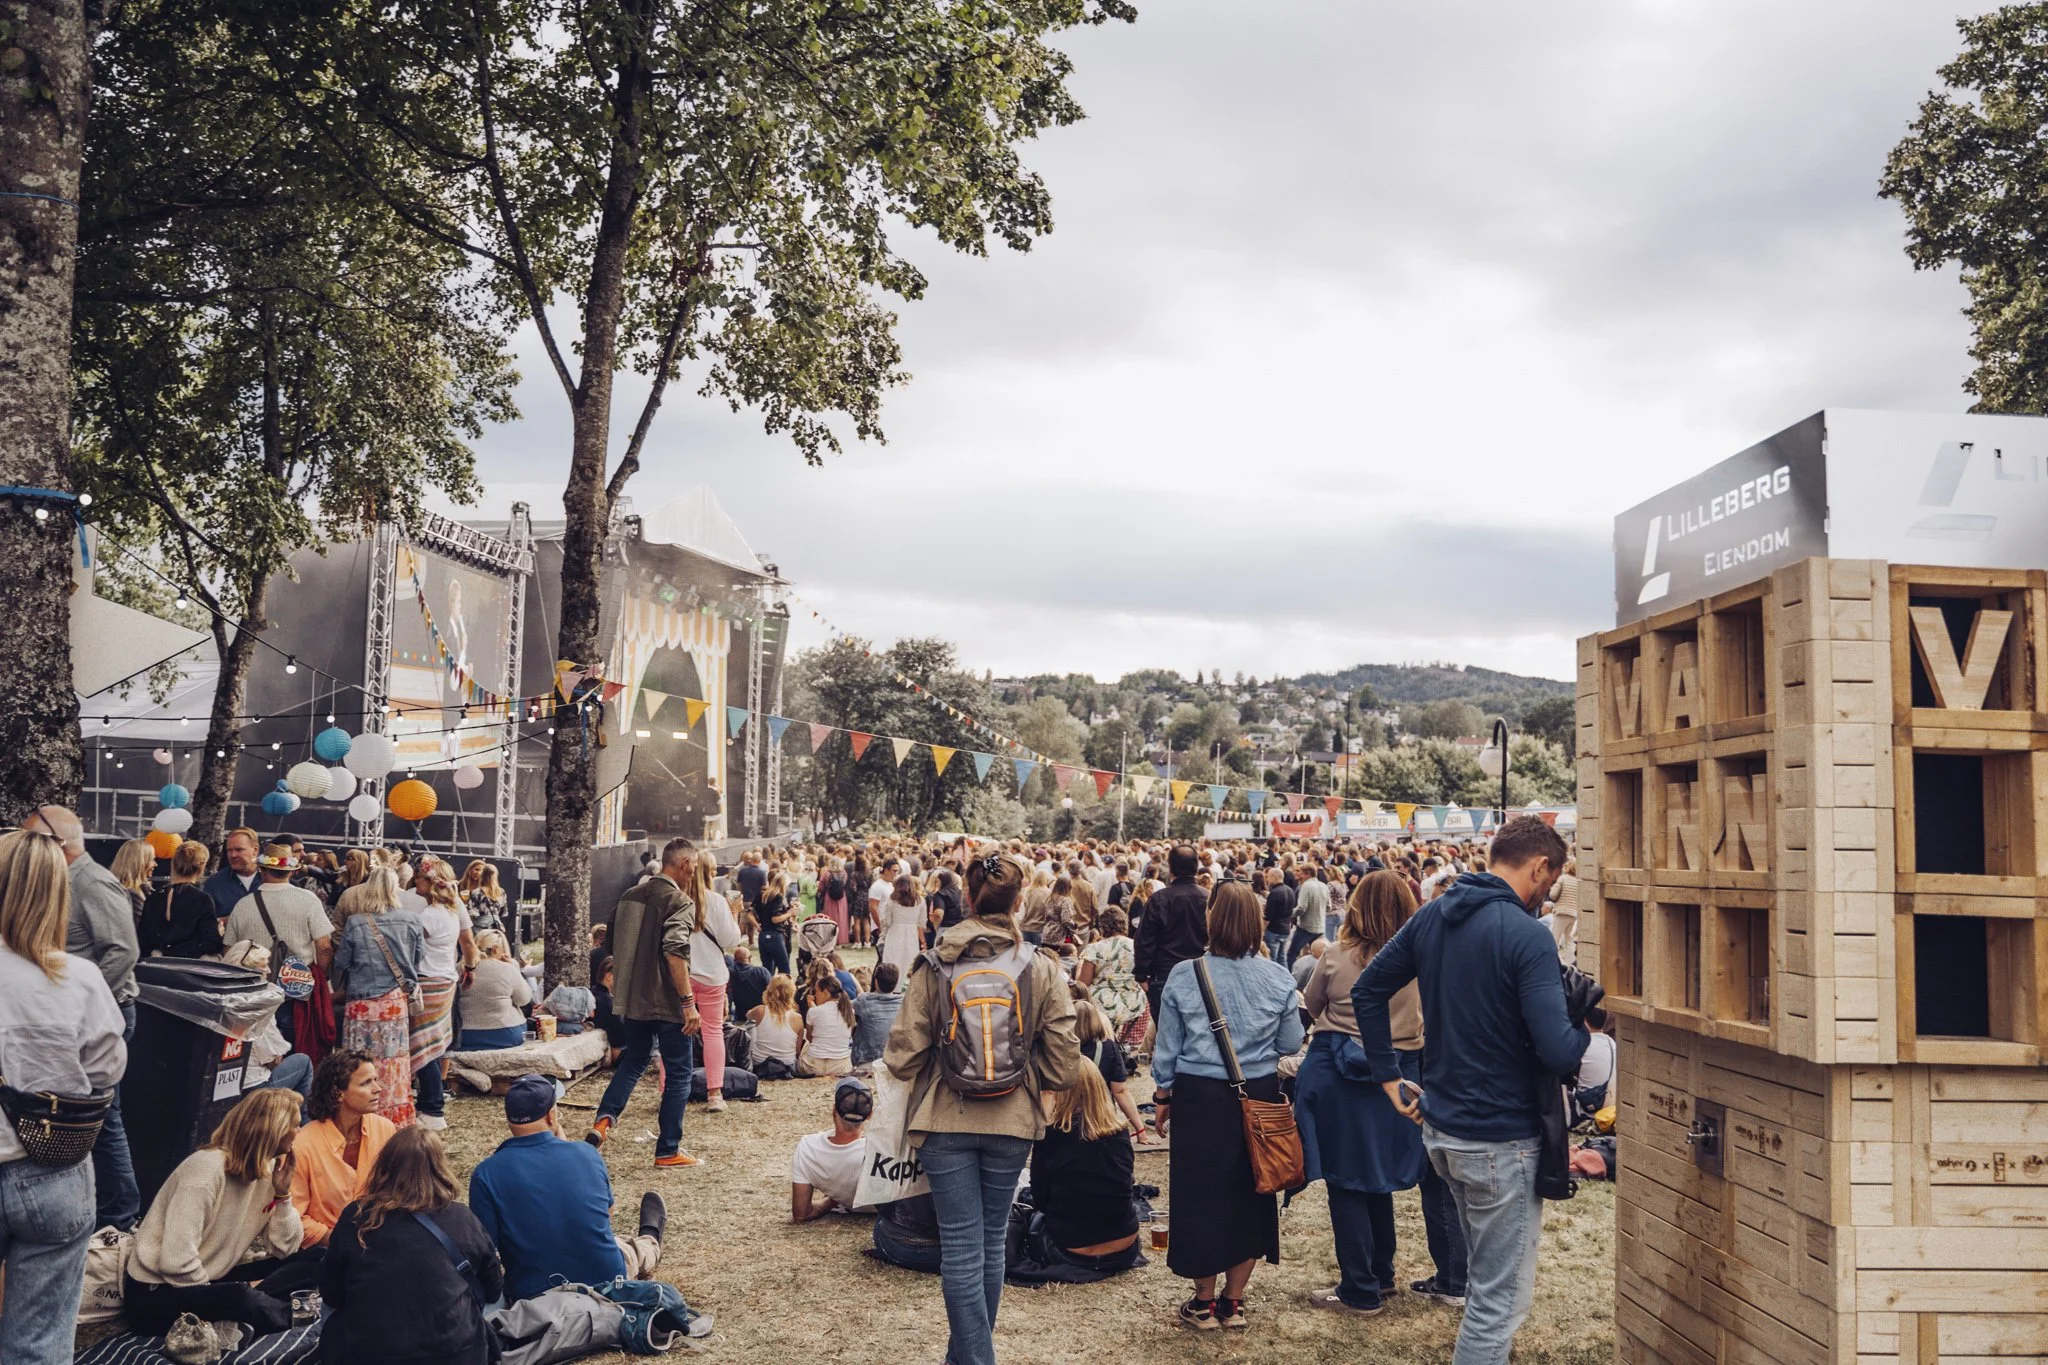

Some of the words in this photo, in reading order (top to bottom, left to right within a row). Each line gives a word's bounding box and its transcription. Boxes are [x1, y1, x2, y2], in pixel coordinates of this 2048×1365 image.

[1667, 465, 1791, 542] LILLEBERG
[1704, 527, 1790, 576] EIENDOM
[225, 1039, 242, 1057] NG
[218, 1070, 240, 1085] PLAST
[870, 1152, 923, 1186] Kapp
